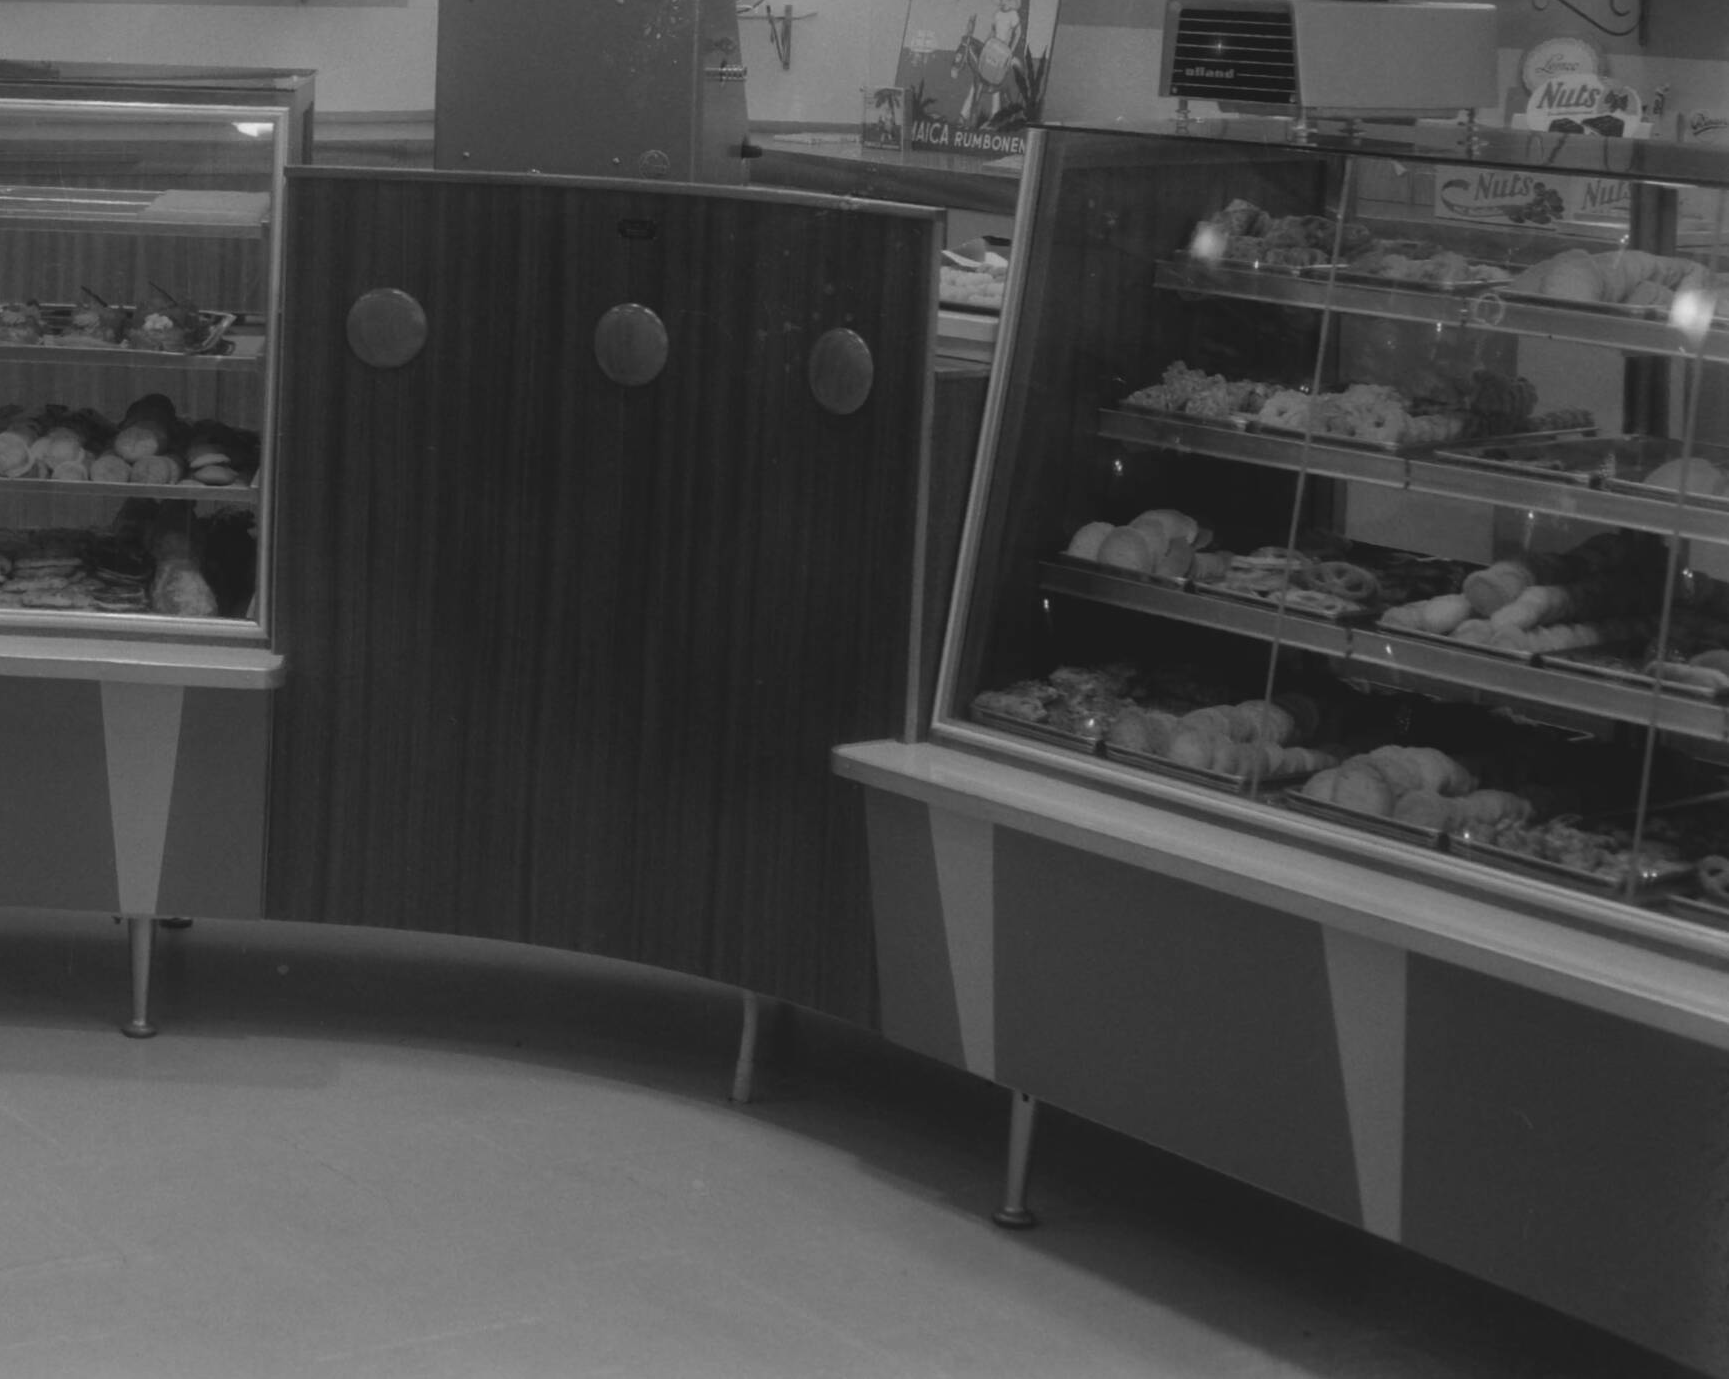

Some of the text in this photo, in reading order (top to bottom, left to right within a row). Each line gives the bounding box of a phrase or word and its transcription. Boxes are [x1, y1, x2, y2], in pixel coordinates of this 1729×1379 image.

[1536, 81, 1601, 109] Nuts
[954, 131, 1027, 154] RUMBONEN
[1474, 172, 1535, 200] Nuts
